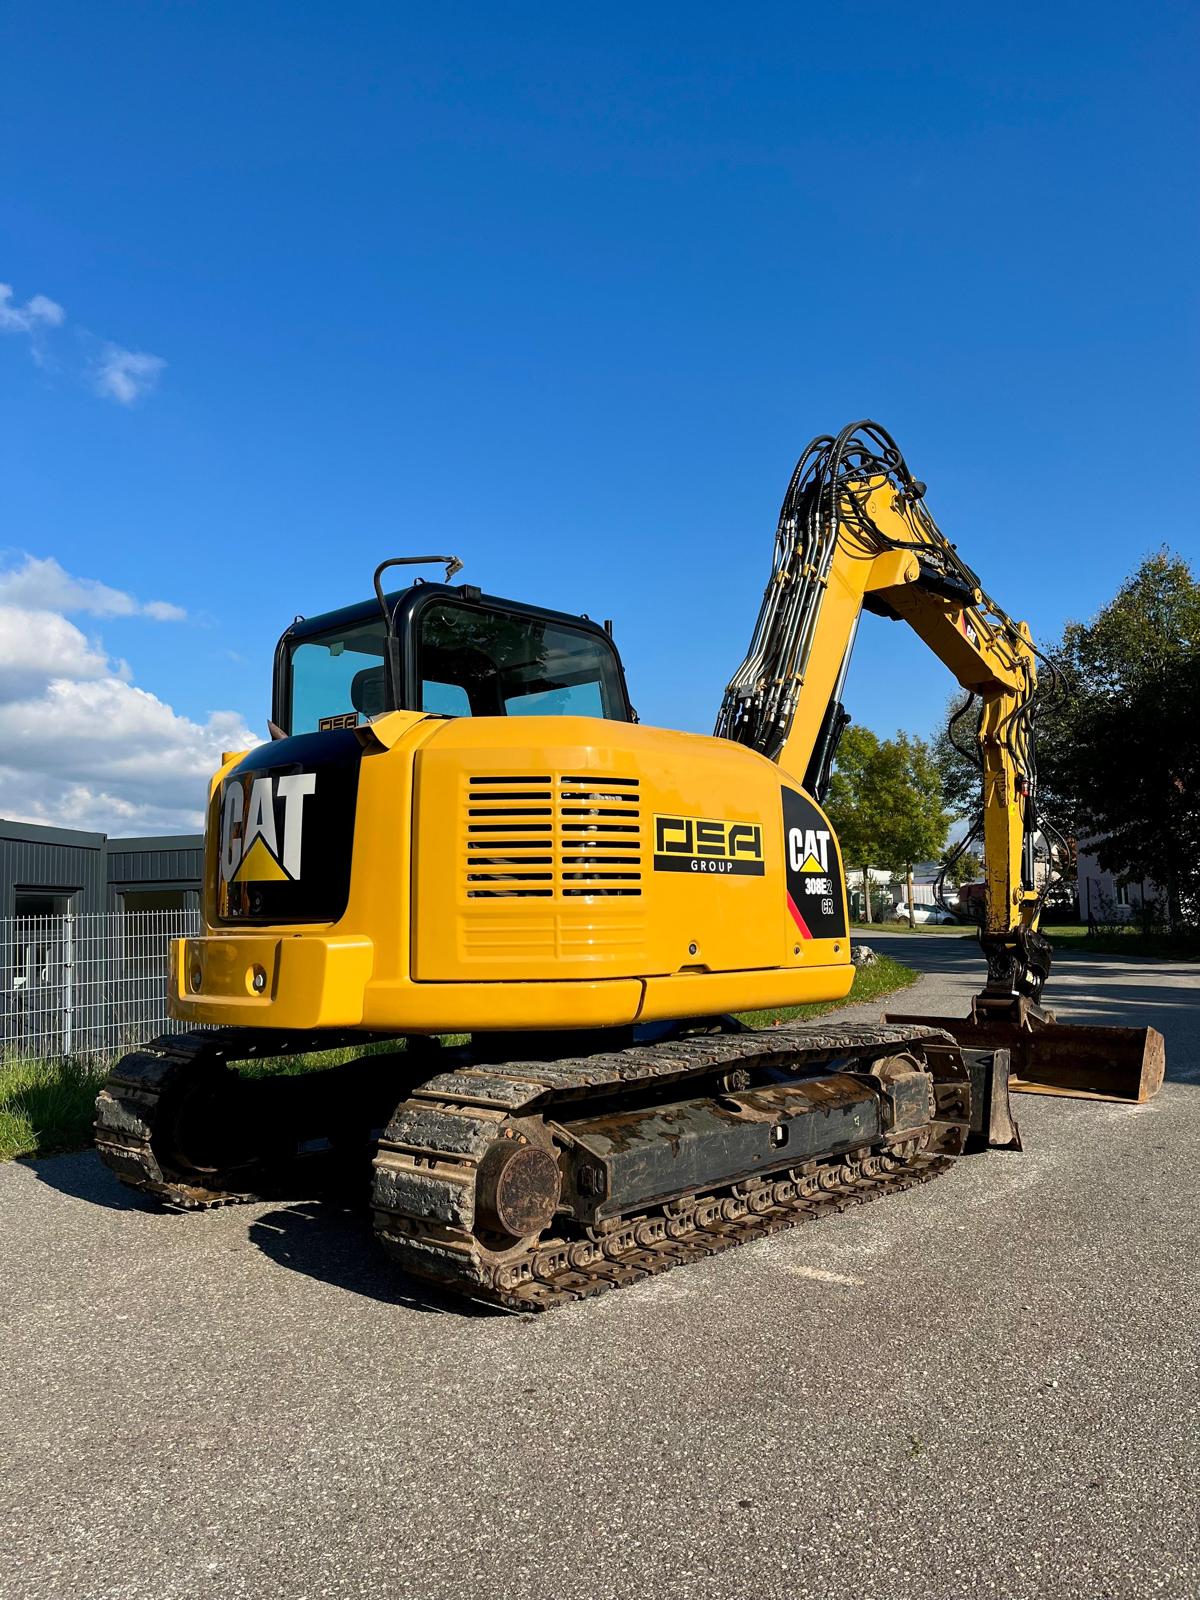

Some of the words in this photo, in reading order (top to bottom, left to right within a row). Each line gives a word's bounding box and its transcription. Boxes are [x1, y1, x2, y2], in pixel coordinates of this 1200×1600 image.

[221, 773, 316, 882] CAT
[690, 859, 733, 872] GROUP
[788, 827, 830, 873] CAT
[821, 898, 834, 915] CR
